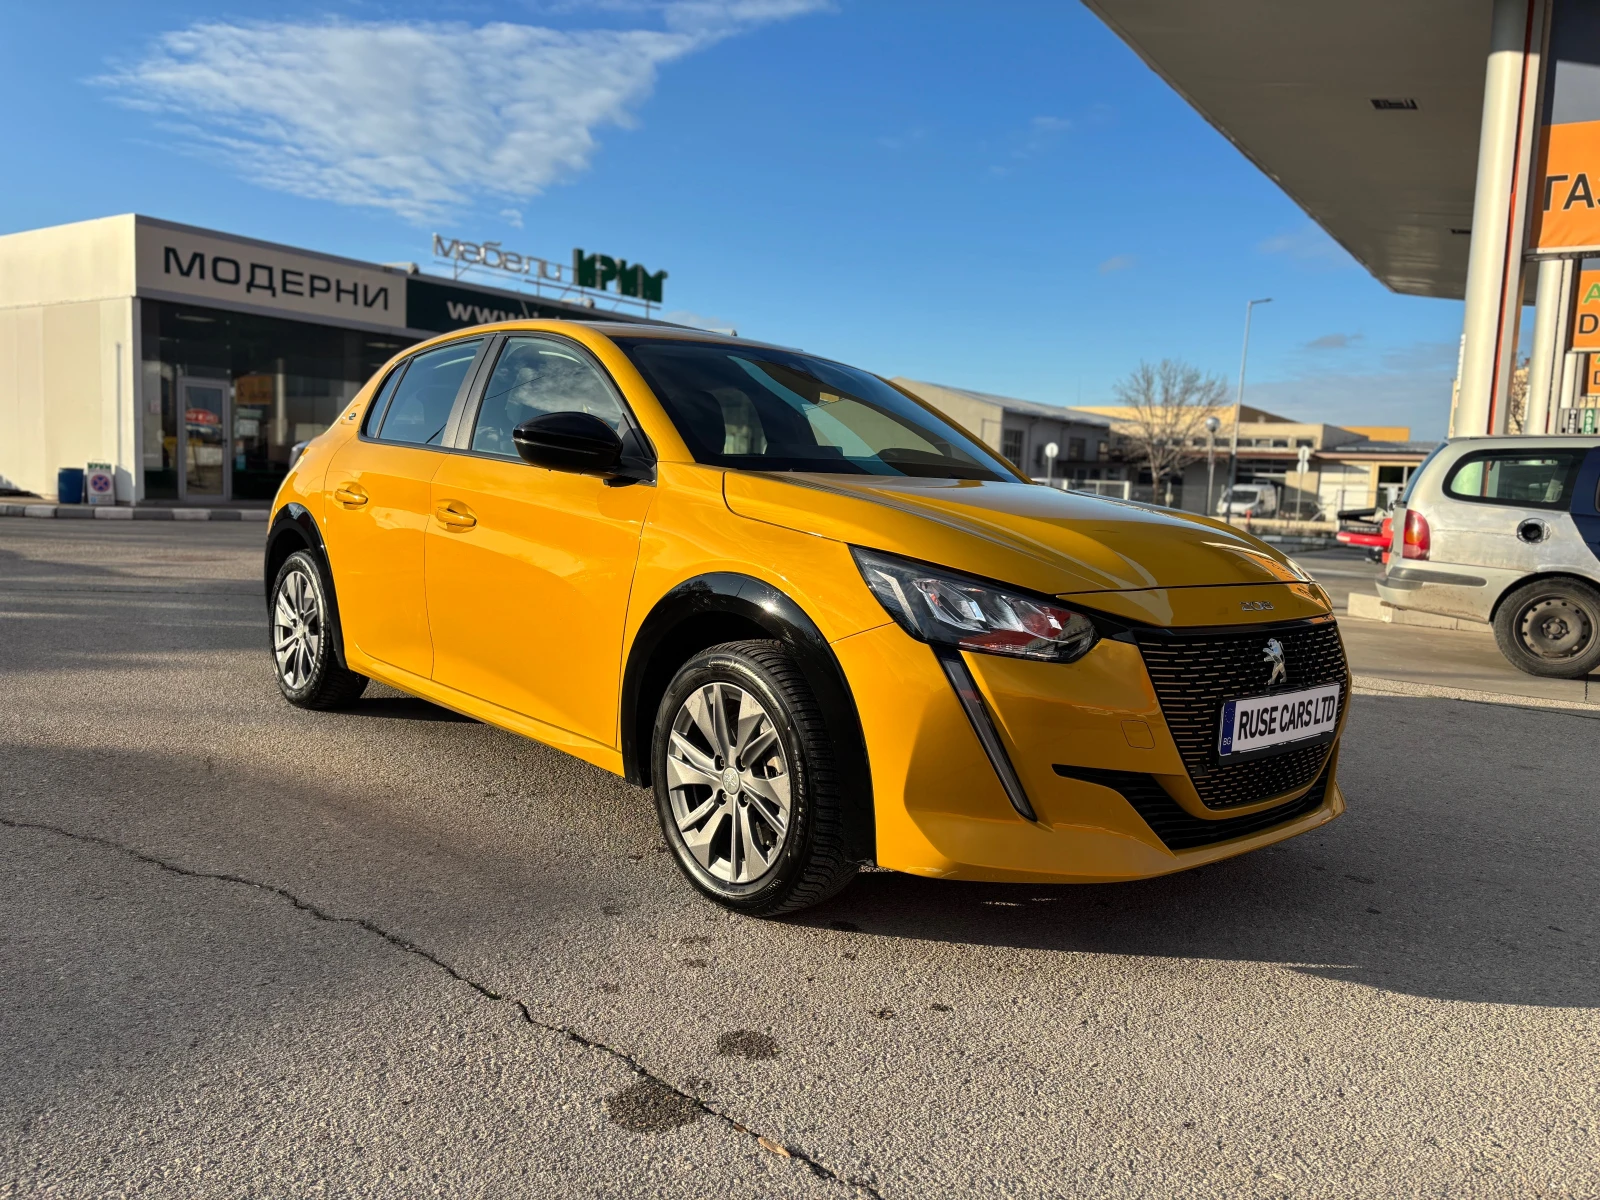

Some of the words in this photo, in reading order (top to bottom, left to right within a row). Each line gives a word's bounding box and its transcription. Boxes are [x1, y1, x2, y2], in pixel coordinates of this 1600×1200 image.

[1543, 173, 1600, 211] ГА
[164, 246, 389, 311] МОДЕРНИ
[1240, 601, 1274, 611] 208
[1237, 706, 1279, 741] RUSE
[1279, 700, 1313, 733] CARS
[1313, 695, 1336, 725] LTD
[1223, 736, 1232, 746] BG
